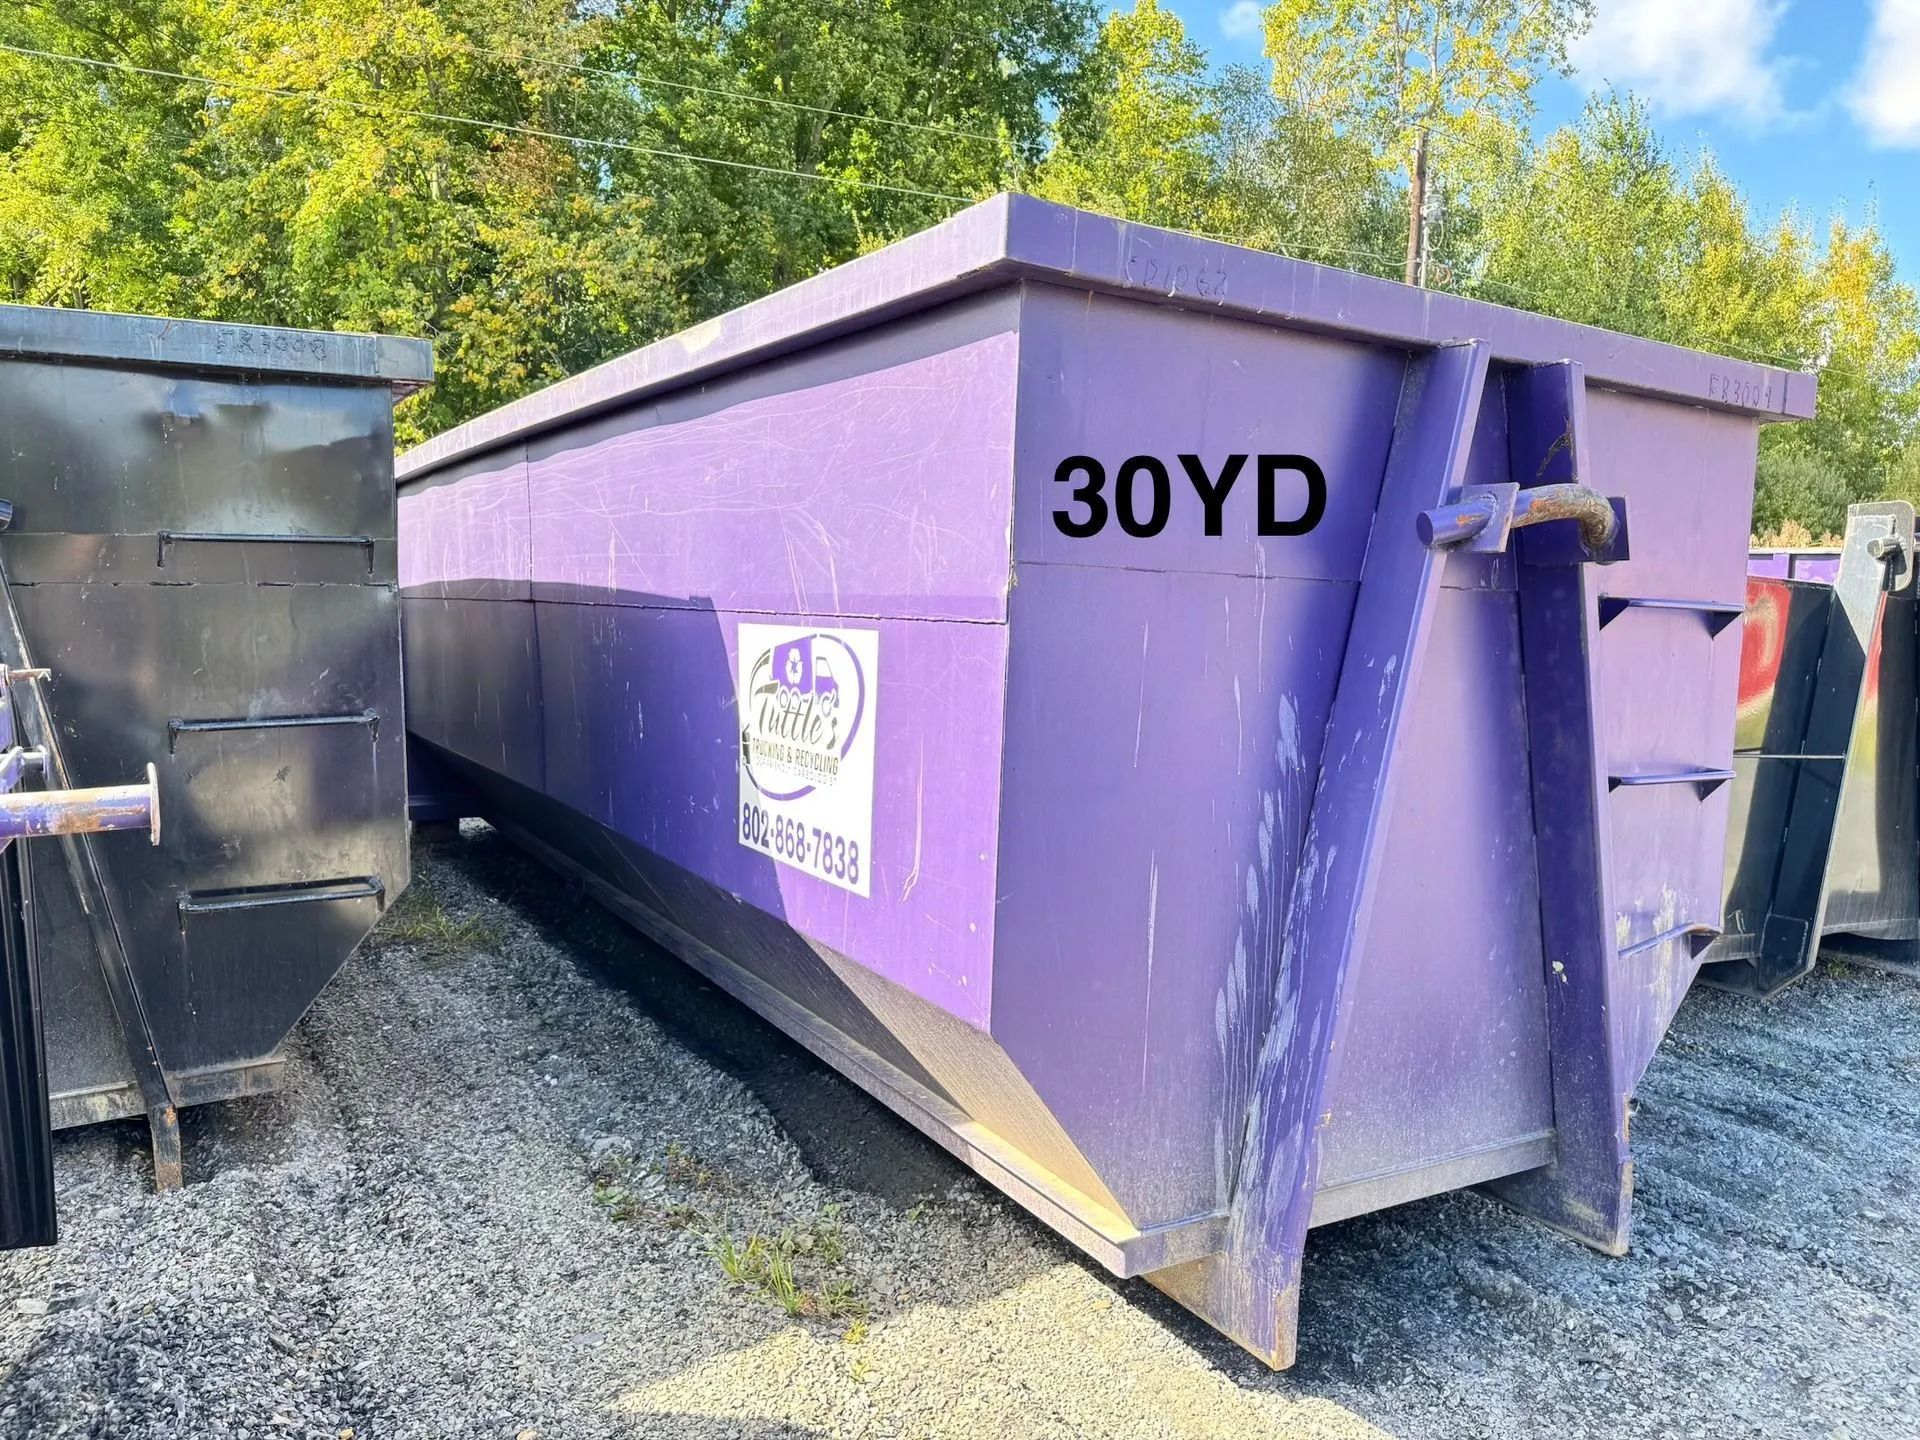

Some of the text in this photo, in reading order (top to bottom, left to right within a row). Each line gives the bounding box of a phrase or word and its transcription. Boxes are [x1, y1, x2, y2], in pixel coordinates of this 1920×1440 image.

[755, 685, 839, 750] Tuttle's
[752, 737, 785, 762] TRUCKING
[786, 745, 793, 764] &
[795, 748, 839, 776] RECYCLING
[742, 802, 859, 885] 802-868-7838
